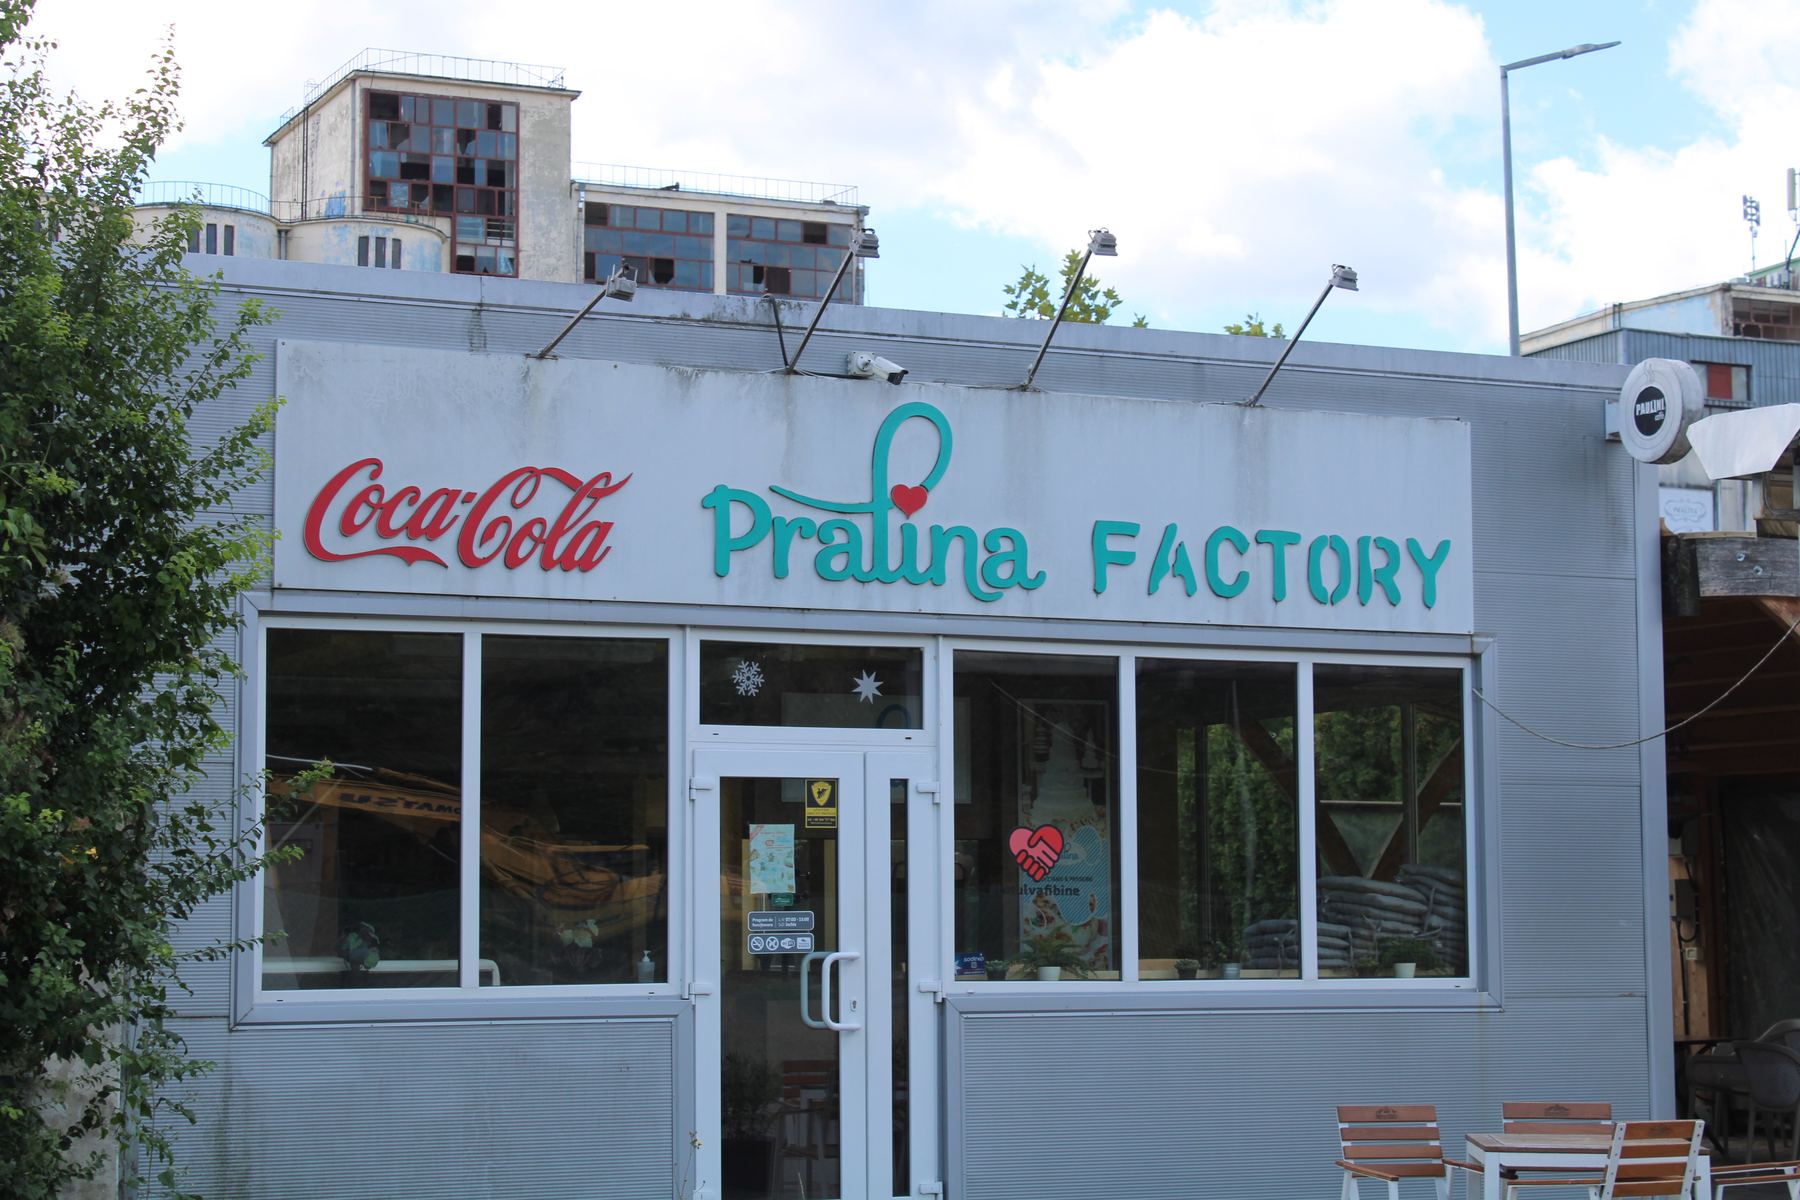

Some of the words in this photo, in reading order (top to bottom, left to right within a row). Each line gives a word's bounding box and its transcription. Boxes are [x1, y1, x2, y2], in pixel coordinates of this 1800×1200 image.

[304, 458, 632, 573] Coca-Cola
[703, 402, 1047, 603] Pralina
[1093, 520, 1452, 610] FACTORY
